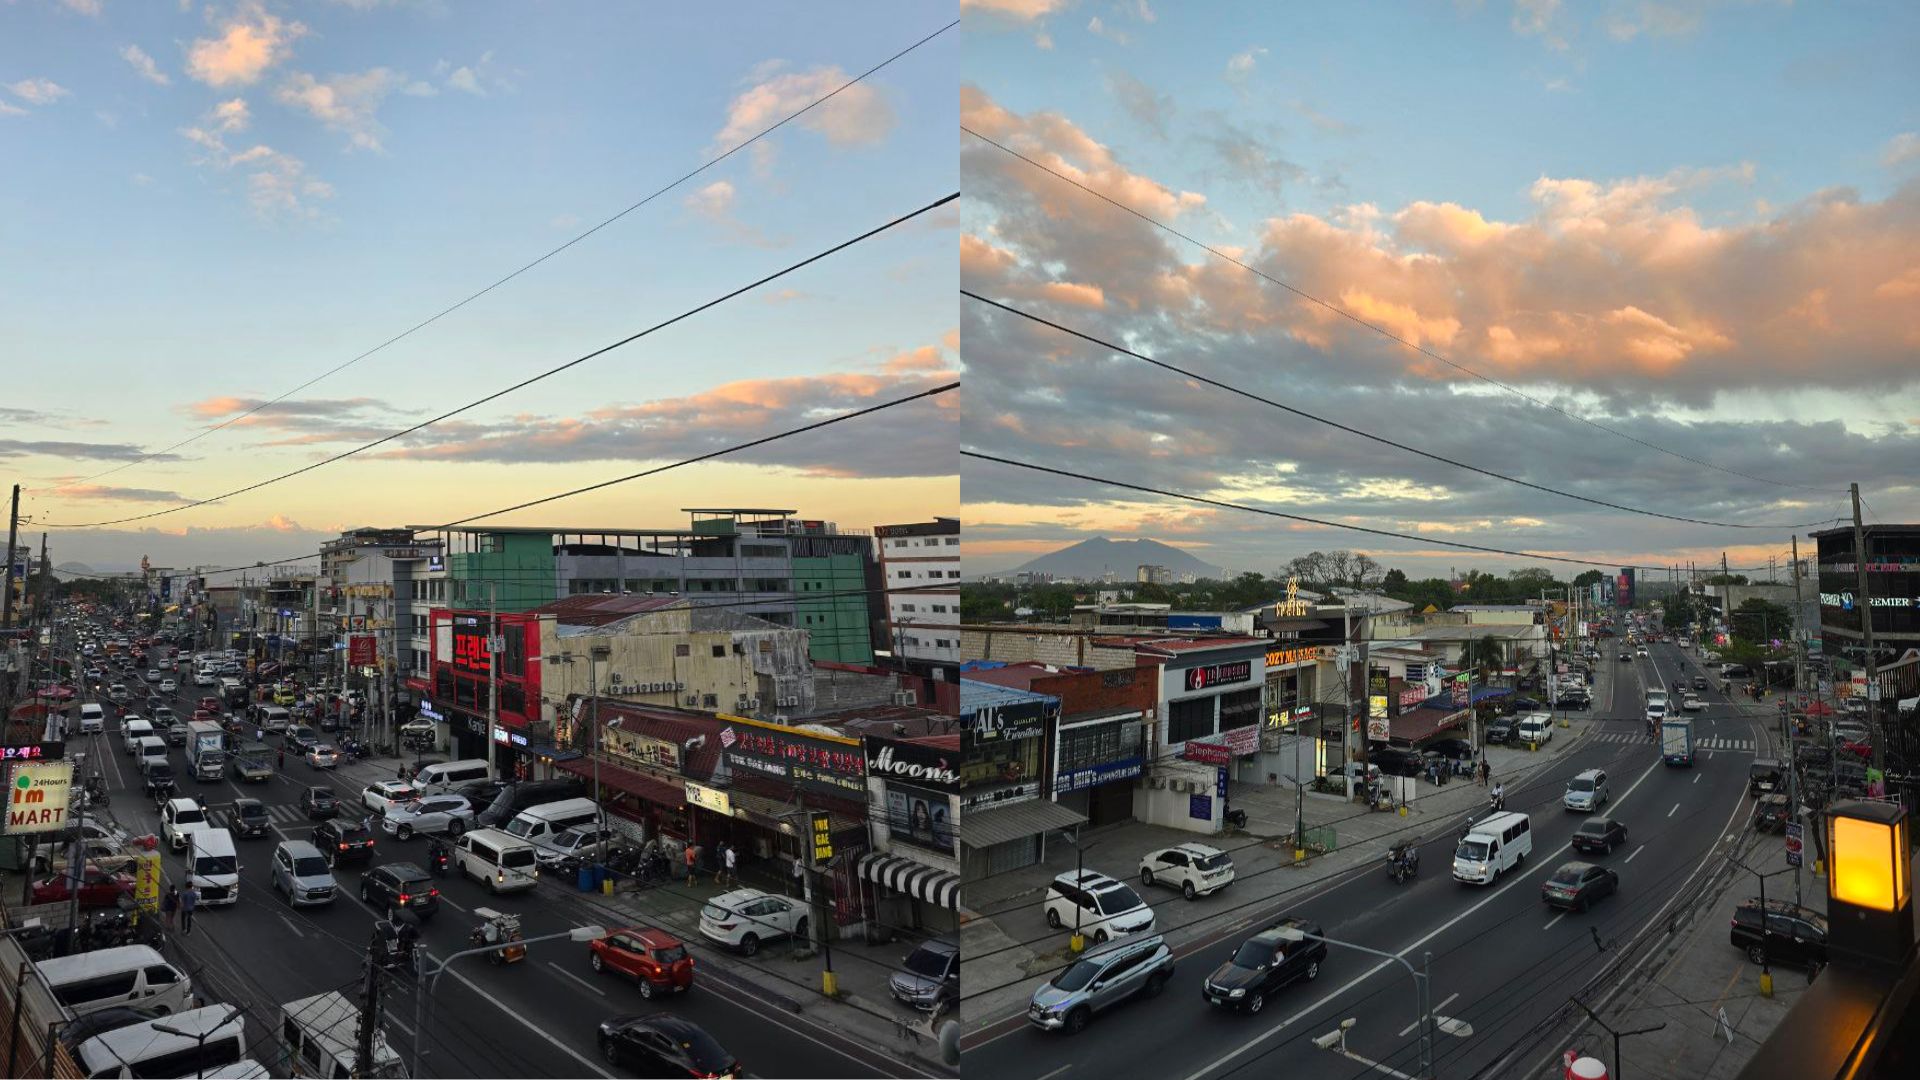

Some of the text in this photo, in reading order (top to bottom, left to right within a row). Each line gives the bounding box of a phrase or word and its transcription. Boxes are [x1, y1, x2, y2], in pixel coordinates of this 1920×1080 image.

[1869, 597, 1909, 607] REMIER
[1286, 647, 1318, 664] MASAGE
[34, 779, 67, 787] 24Hours
[10, 808, 64, 826] MART
